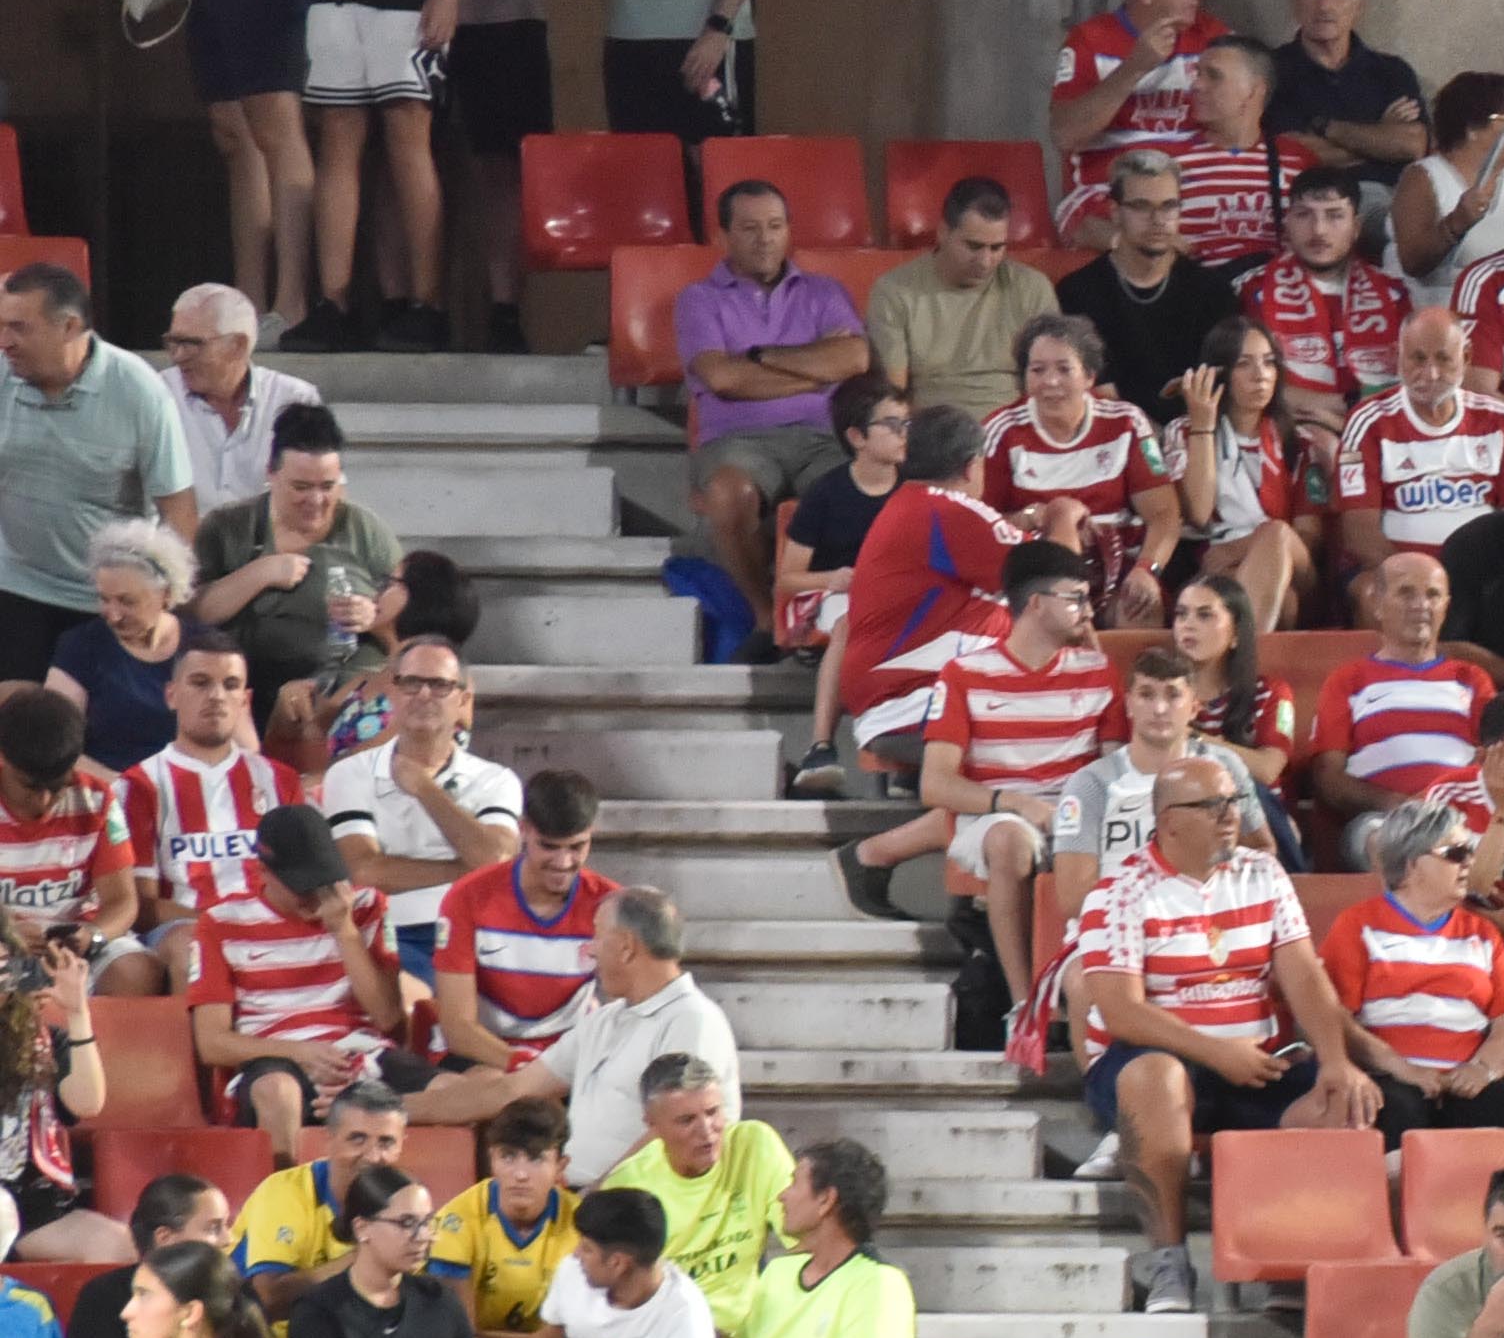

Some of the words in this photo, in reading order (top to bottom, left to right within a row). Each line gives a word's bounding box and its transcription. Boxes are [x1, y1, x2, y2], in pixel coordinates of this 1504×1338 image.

[1399, 479, 1491, 507] wiber
[170, 834, 257, 860] PULEV
[0, 873, 80, 907] latzi
